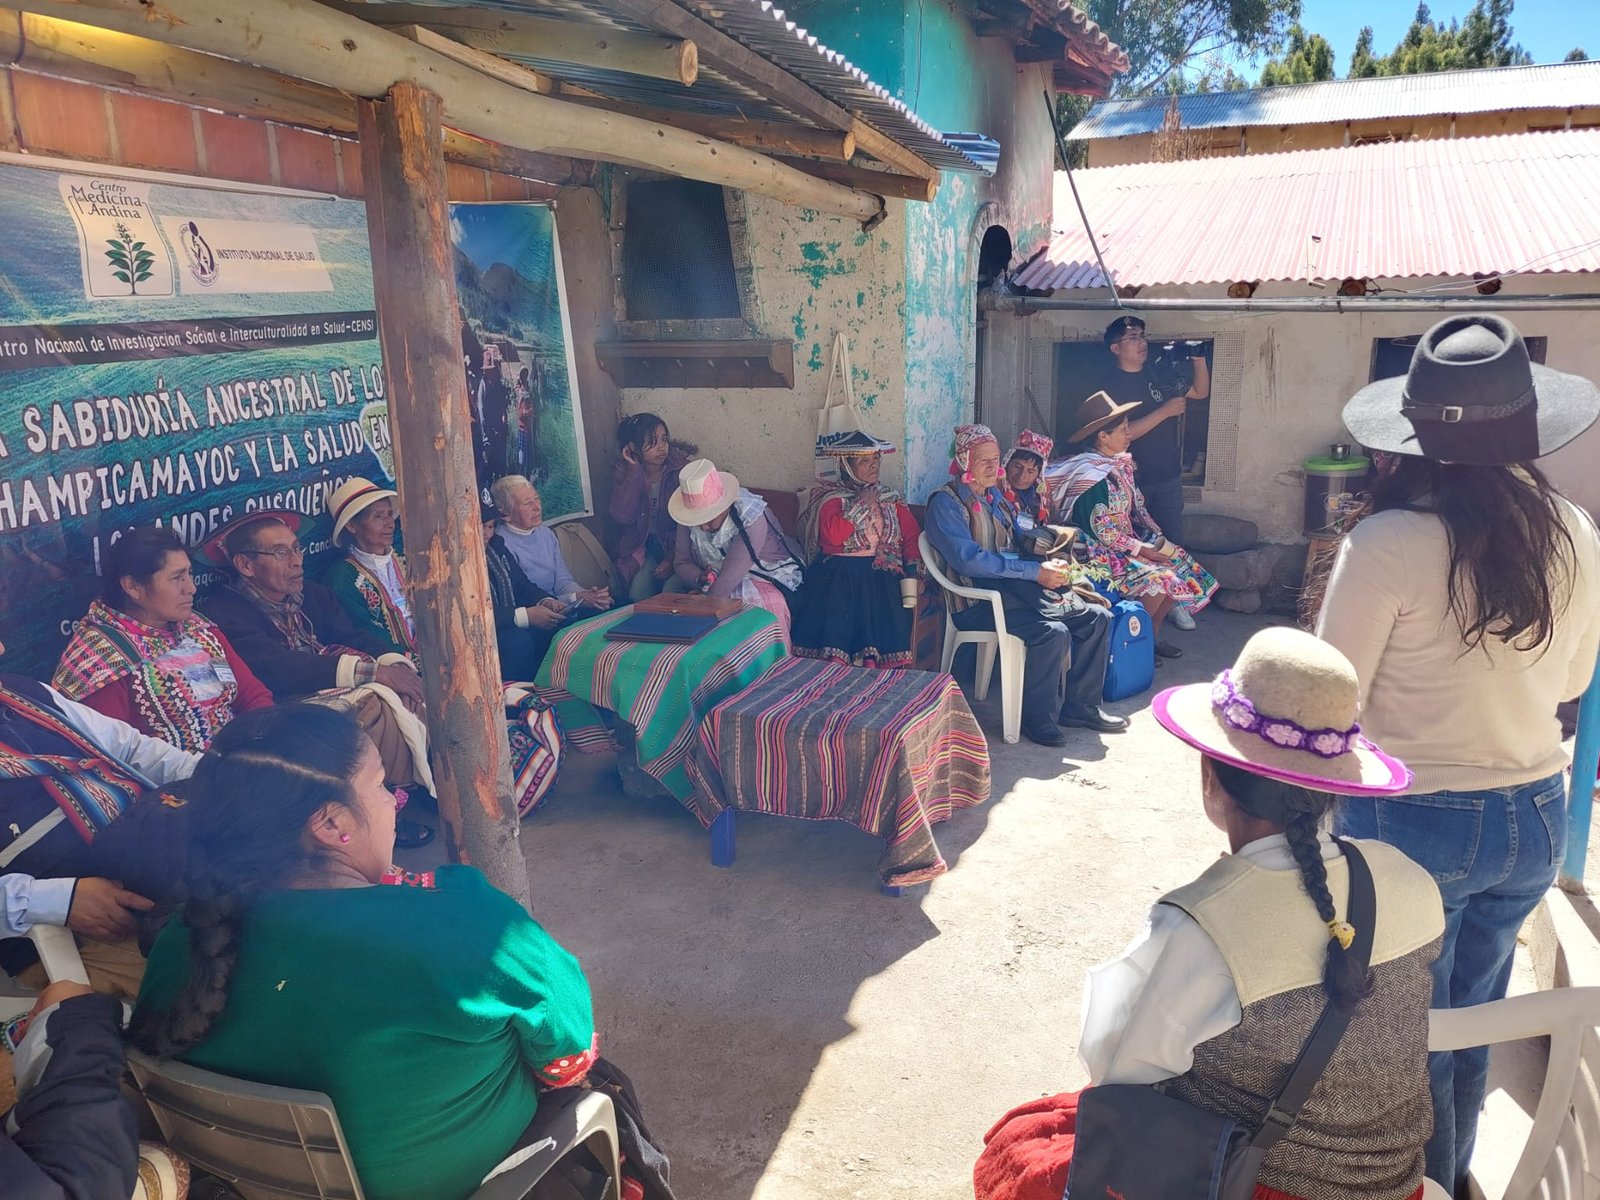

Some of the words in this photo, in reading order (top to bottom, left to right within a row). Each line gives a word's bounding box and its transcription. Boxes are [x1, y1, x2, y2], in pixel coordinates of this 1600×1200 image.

[70, 184, 142, 214] Medicina
[90, 180, 126, 193] Centro
[88, 203, 142, 219] Andina
[216, 249, 252, 260] INSTITUTO
[251, 250, 285, 261] NACIONAL
[284, 251, 295, 261] DE
[295, 251, 316, 261] SALUD
[35, 337, 87, 355] Nacional
[91, 336, 105, 352] de
[107, 333, 182, 351] Investigacion
[220, 331, 227, 342] e
[230, 323, 308, 342] Interculturalidad
[311, 326, 321, 336] en
[324, 319, 374, 334] Salud-CENSI
[23, 378, 199, 453] SABIDURÍA
[206, 373, 327, 427] ANCESTRAL
[330, 369, 356, 405] DE
[359, 364, 384, 400] LO
[244, 440, 261, 478] Y
[266, 434, 299, 473] LA
[304, 420, 364, 465] SALUD
[370, 414, 392, 450] EN
